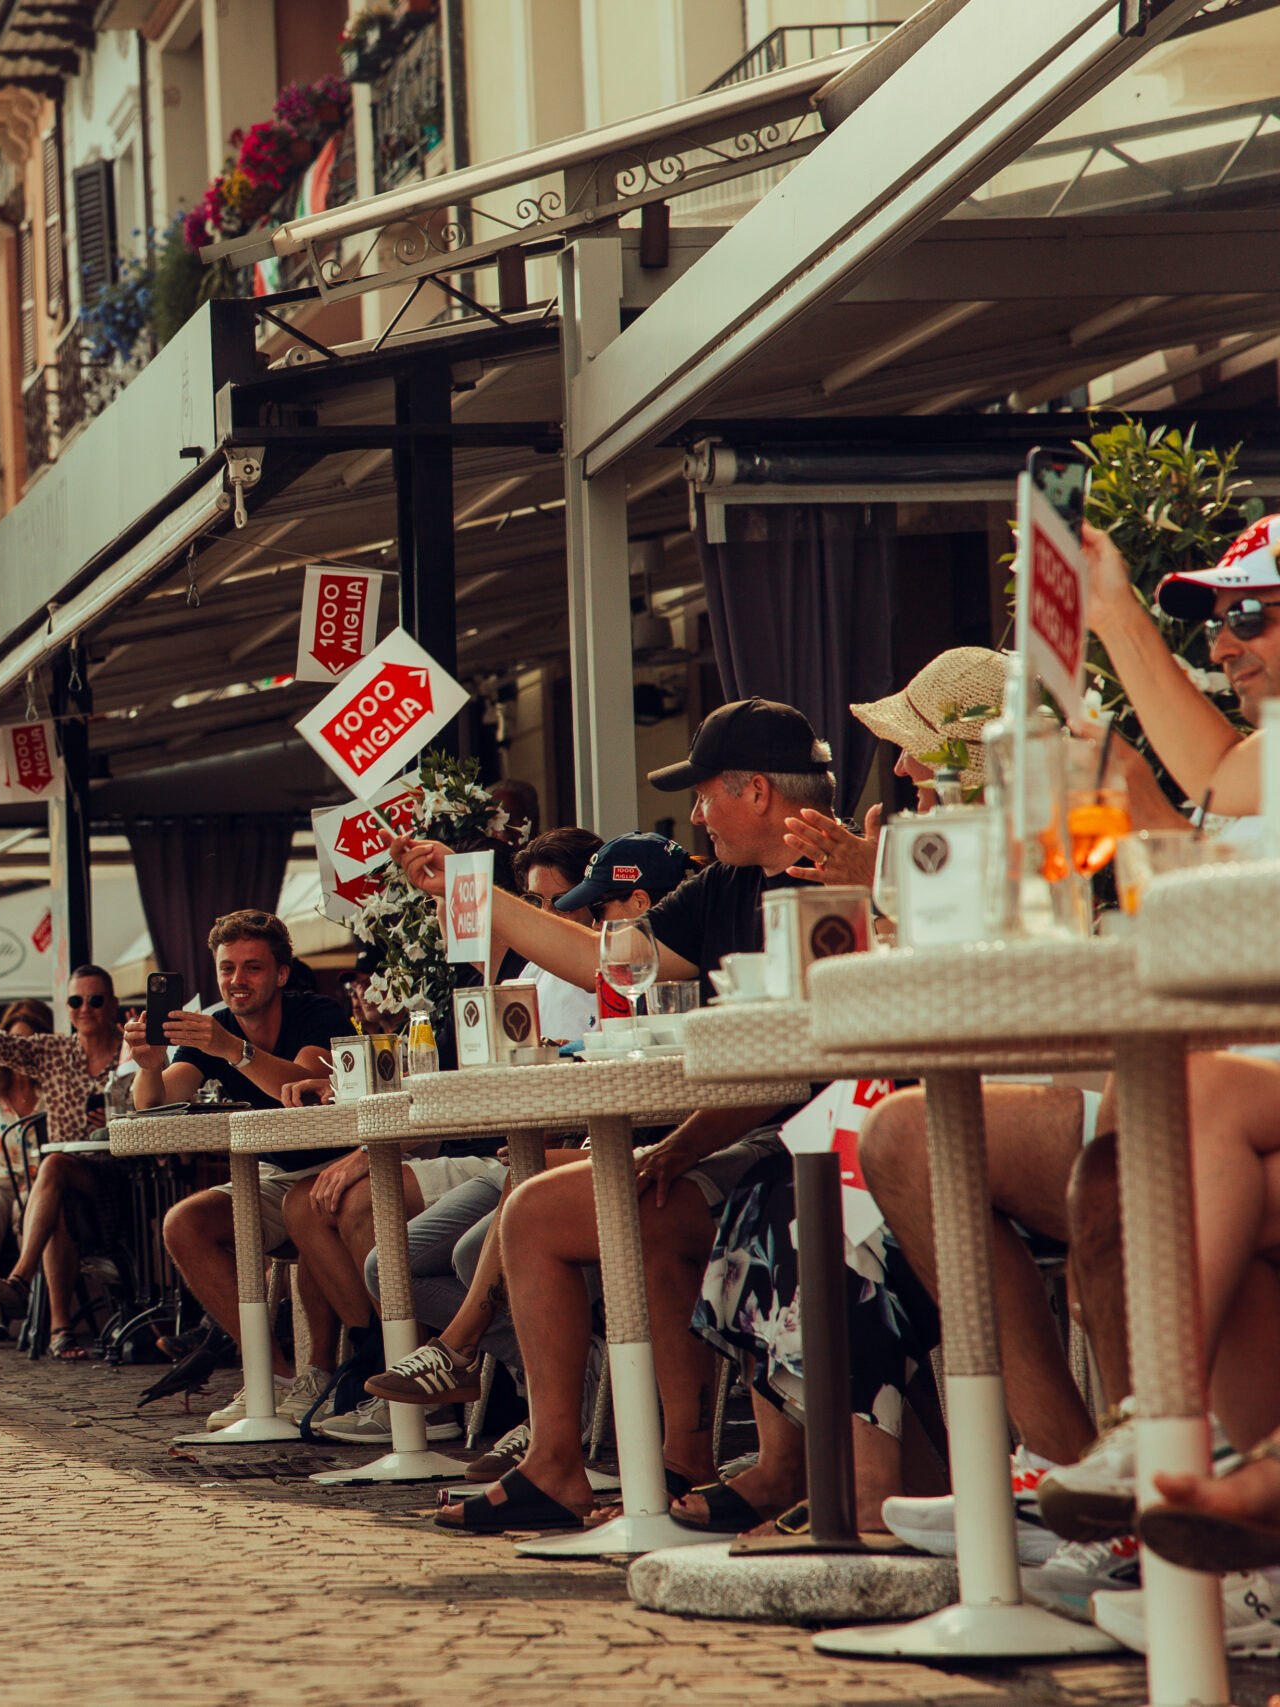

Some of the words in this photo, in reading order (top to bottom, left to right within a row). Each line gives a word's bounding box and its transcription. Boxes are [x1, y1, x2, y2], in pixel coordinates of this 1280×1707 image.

[319, 584, 340, 647] 1000
[341, 581, 364, 654] MIGLIA
[334, 680, 395, 741] 1000
[349, 697, 423, 769] MIGLIA
[16, 733, 32, 777] 1000
[31, 727, 49, 777] MIGLIA
